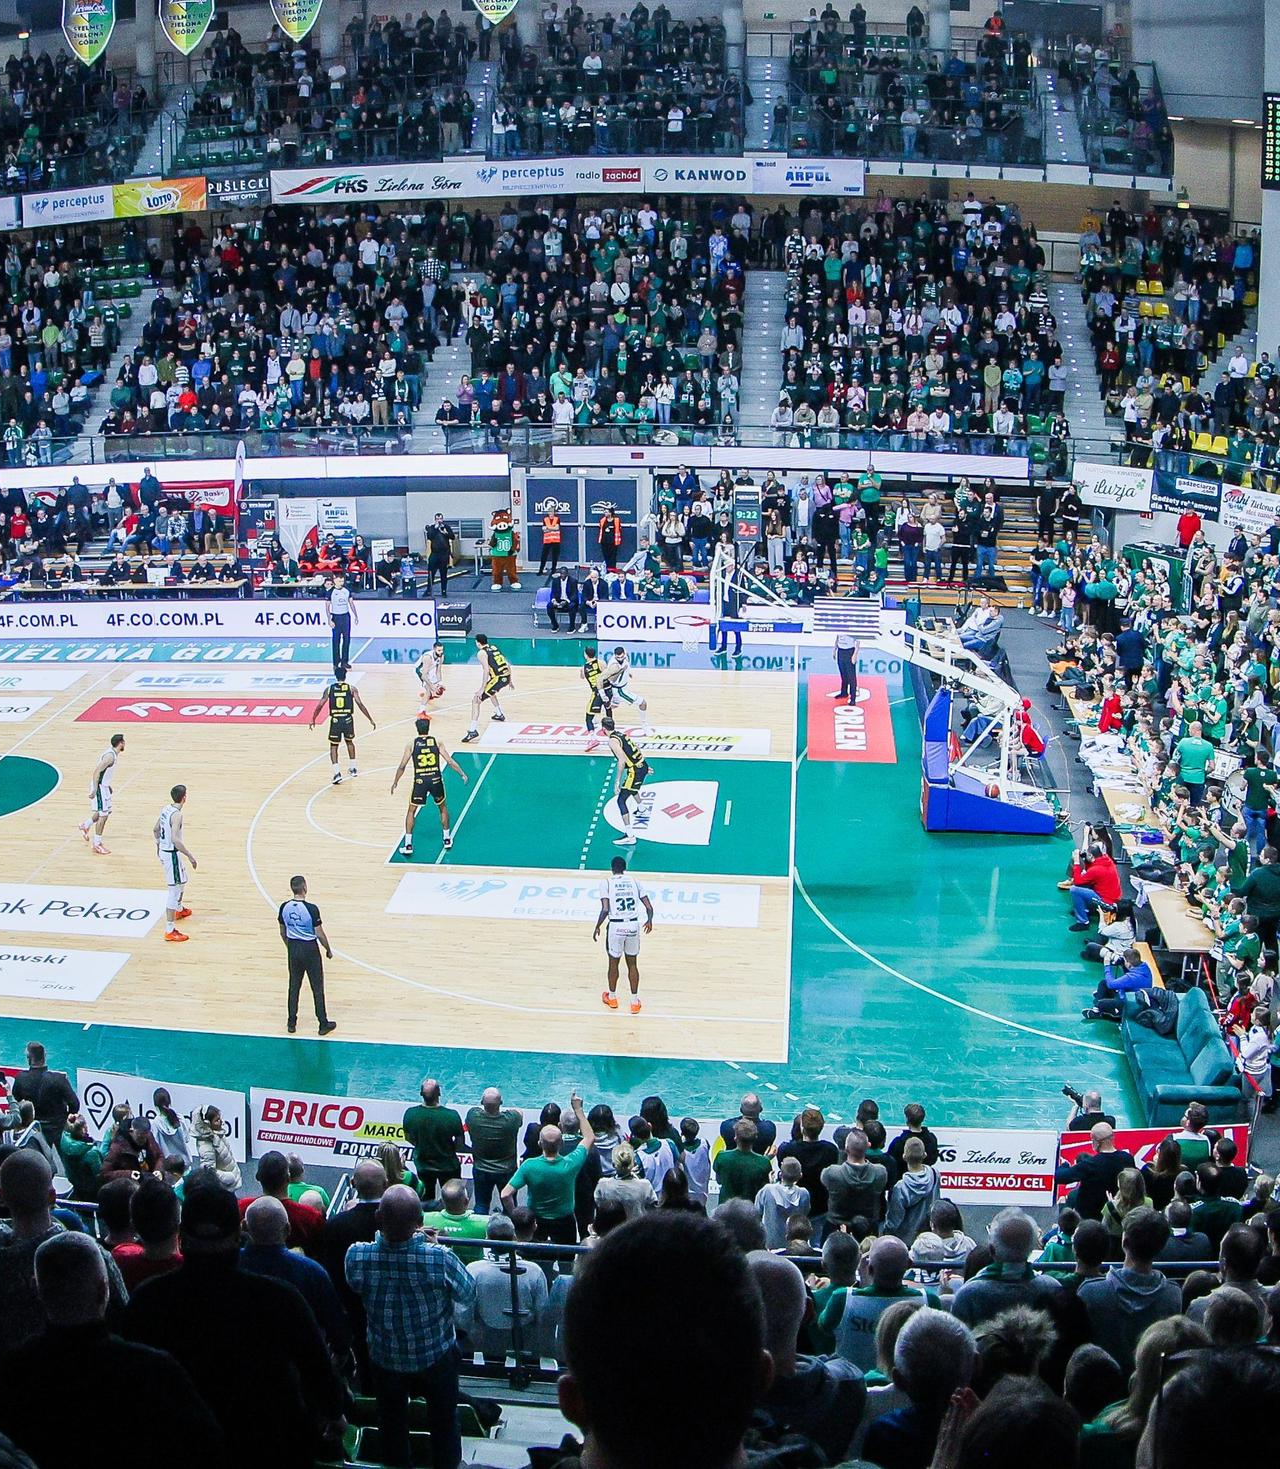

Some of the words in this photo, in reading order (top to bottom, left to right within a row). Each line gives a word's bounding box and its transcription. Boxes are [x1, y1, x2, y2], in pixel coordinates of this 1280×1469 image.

[501, 166, 565, 182] perceptus
[575, 170, 600, 180] radio
[605, 169, 639, 181] zachód
[674, 168, 747, 181] KANWOD
[785, 170, 832, 182] ARPOL
[333, 179, 369, 195] PKS
[374, 178, 425, 194] Zielona
[431, 175, 462, 191] Góra
[52, 194, 105, 212] perceptus
[146, 193, 173, 208] LOTTO
[1093, 479, 1137, 503] iluzja
[1178, 480, 1217, 491] gadzeciarze
[1151, 493, 1179, 506] Gadżety
[1224, 490, 1251, 506] Sushi
[1151, 503, 1162, 511] dla
[736, 511, 758, 520] 9:22
[738, 522, 758, 537] 2,5
[379, 612, 432, 626] 4F.CO
[170, 645, 296, 661] GÓRA
[336, 696, 344, 709] 0
[178, 705, 305, 717] ORLEN
[834, 705, 867, 752] ORLEN
[655, 734, 735, 743] MARCHE
[417, 753, 436, 767] 33
[38, 899, 152, 922] Pekao
[615, 897, 636, 912] 32
[260, 1097, 365, 1131] BRICO
[363, 1124, 404, 1139] MARC
[260, 1131, 295, 1143] CENTRUM
[294, 1134, 335, 1148] HANDLOWE
[962, 1149, 1012, 1166] Zielona
[1018, 1150, 1048, 1166] Góra
[985, 1173, 1022, 1188] SWÓJ
[1023, 1176, 1046, 1190] CEL
